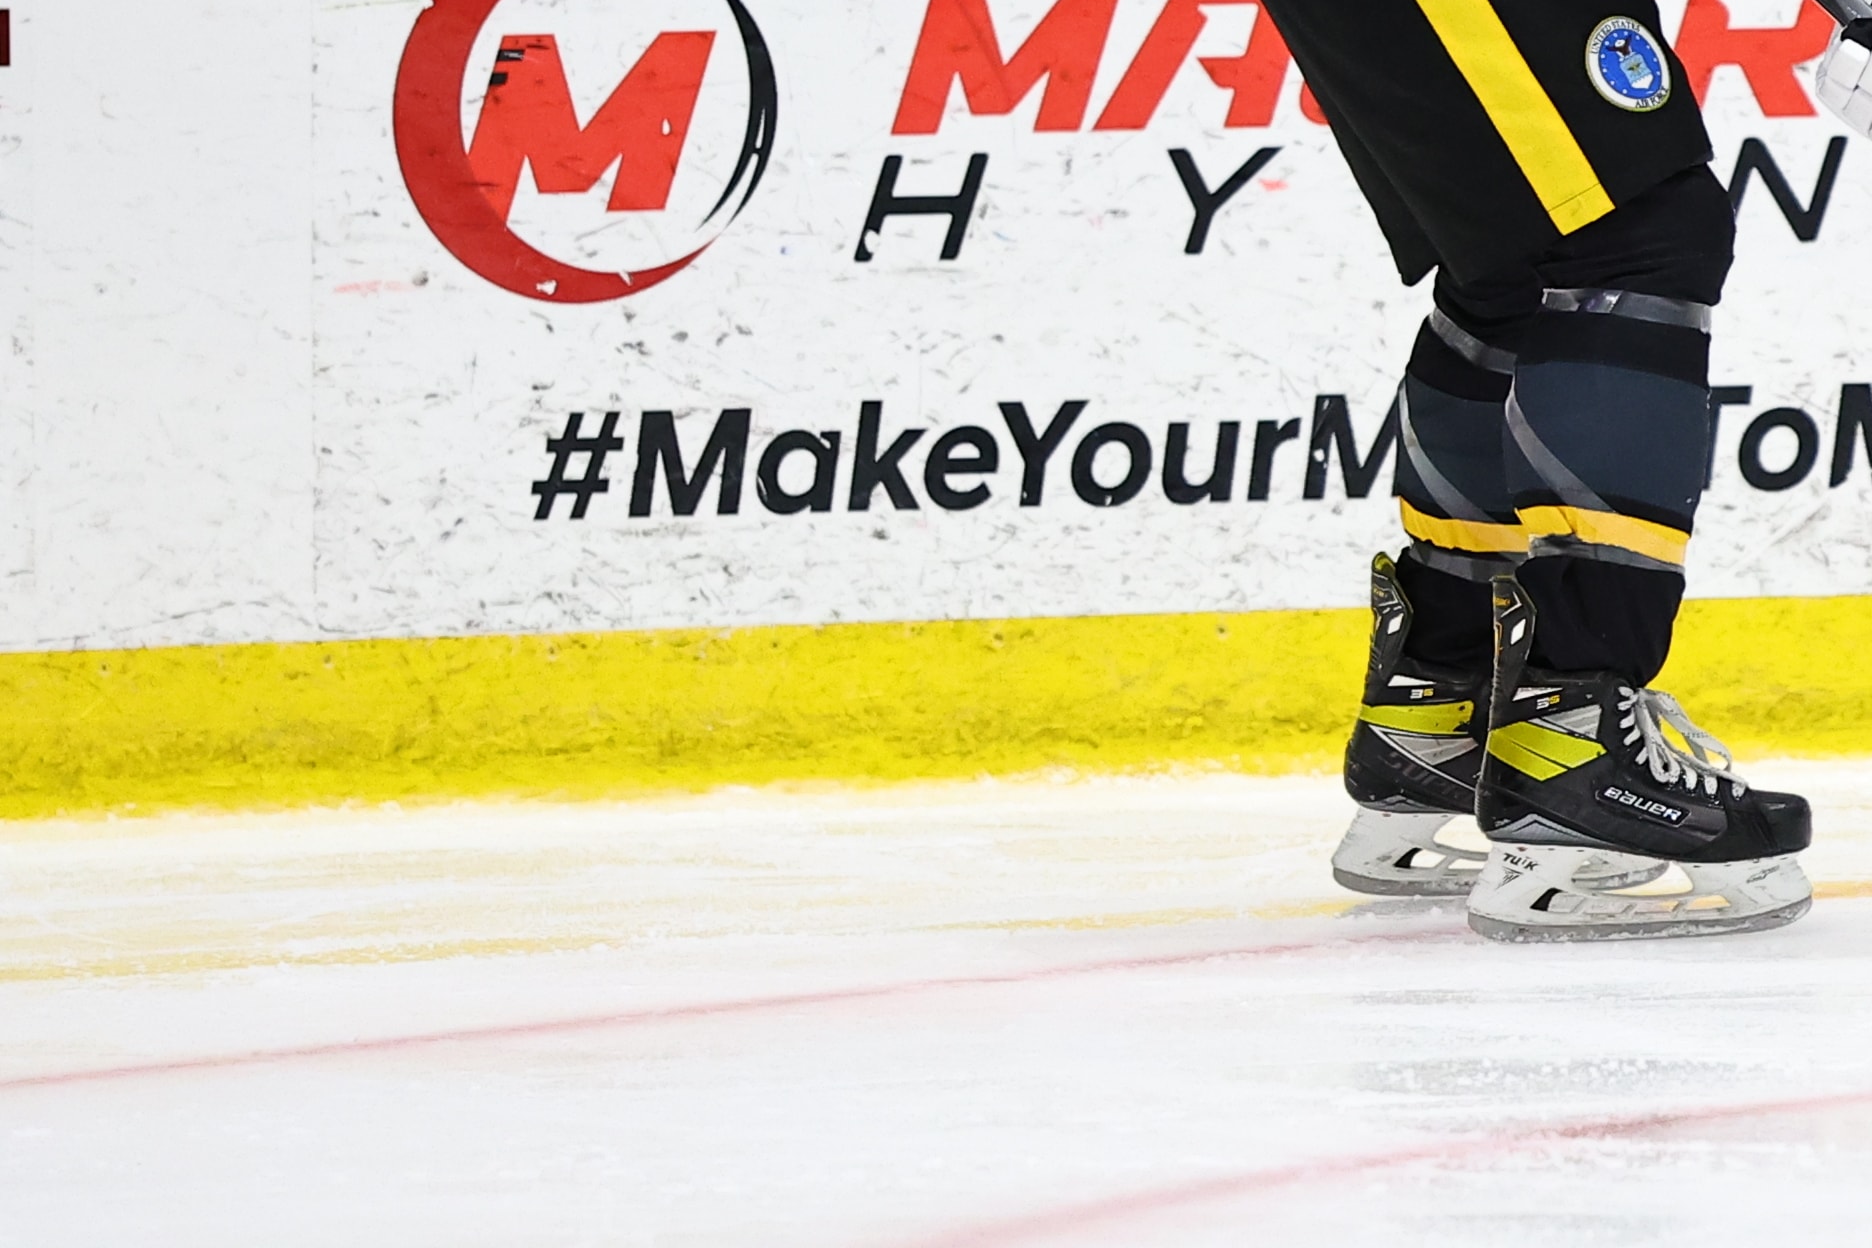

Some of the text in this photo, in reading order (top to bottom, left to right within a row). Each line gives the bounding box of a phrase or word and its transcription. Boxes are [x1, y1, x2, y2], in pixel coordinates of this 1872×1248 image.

[1591, 19, 1641, 55] UNITED STATES
[1635, 97, 1650, 109] AIR
[1602, 785, 1683, 822] BAUER
